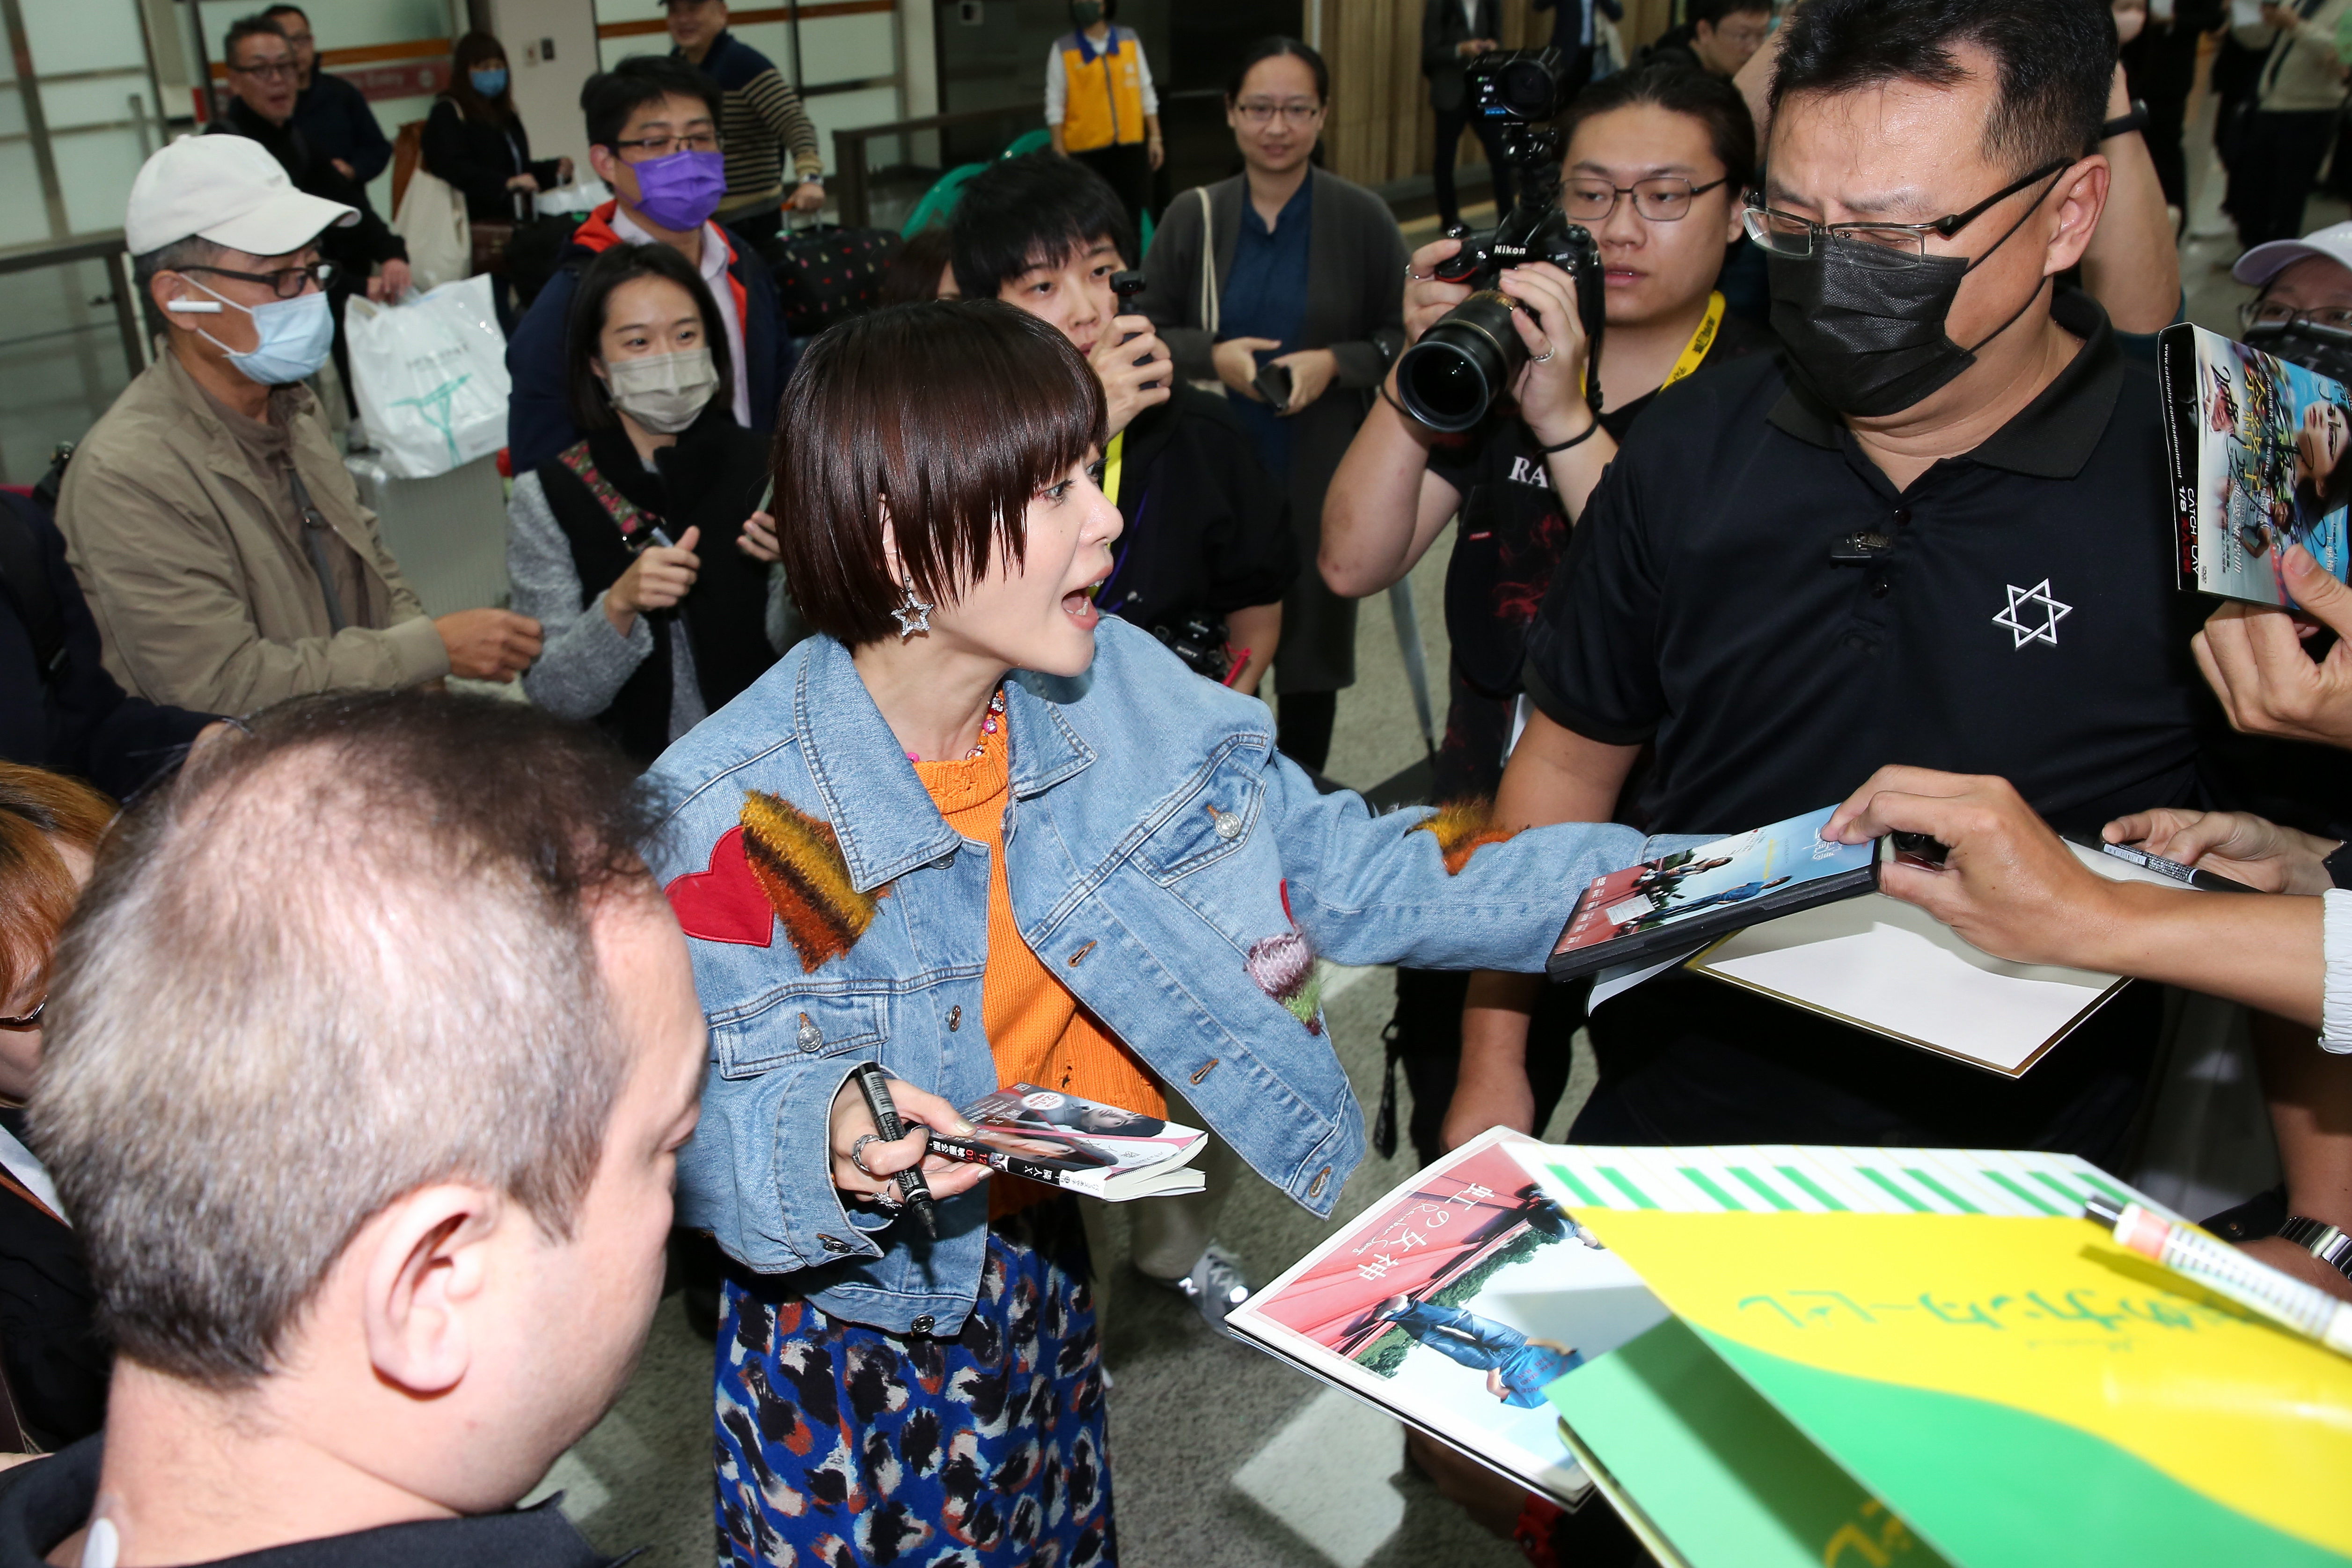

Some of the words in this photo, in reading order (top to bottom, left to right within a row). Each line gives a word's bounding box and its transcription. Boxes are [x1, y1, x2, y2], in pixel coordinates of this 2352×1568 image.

[1494, 245, 1526, 256] Nikon
[2164, 343, 2182, 478] www.catchplay.com/badlieutenant
[2242, 362, 2266, 496] 奈緒子
[2187, 488, 2199, 575] CATCHPLAY
[2325, 535, 2335, 572] 上野樹
[1023, 1165, 1053, 1180] 隣人X
[1357, 1183, 1495, 1281] 虹の女神
[1383, 1202, 1440, 1236] Rainbow
[1352, 1236, 1389, 1257] Song
